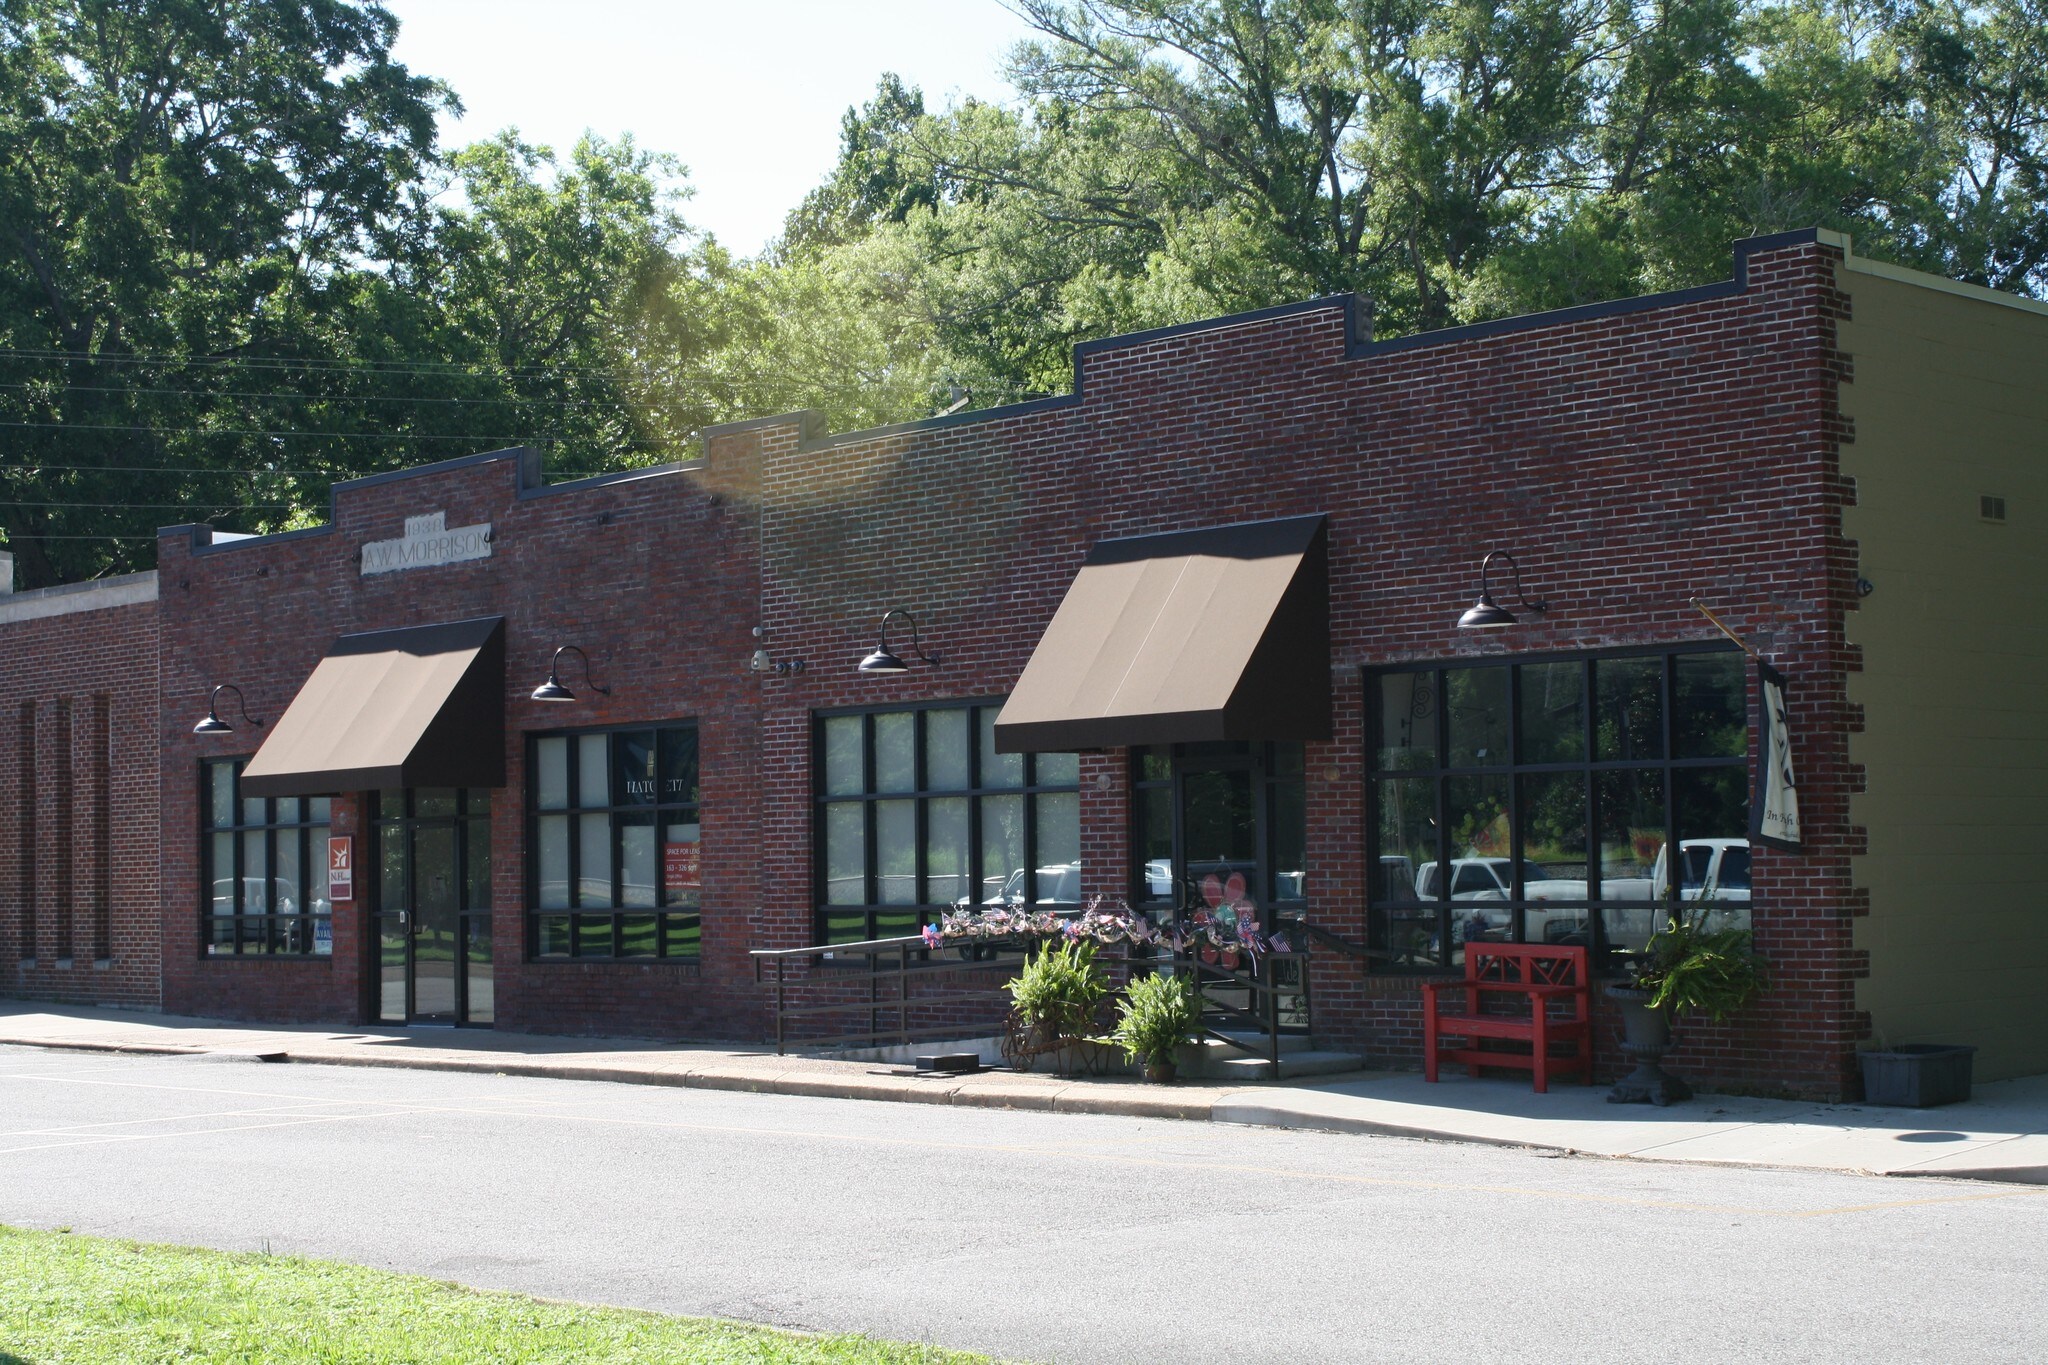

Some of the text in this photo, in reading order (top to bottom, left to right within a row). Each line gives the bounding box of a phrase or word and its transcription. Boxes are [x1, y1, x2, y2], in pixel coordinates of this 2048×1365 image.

[407, 518, 442, 537] 1938
[364, 532, 489, 570] A.W. MORRISON
